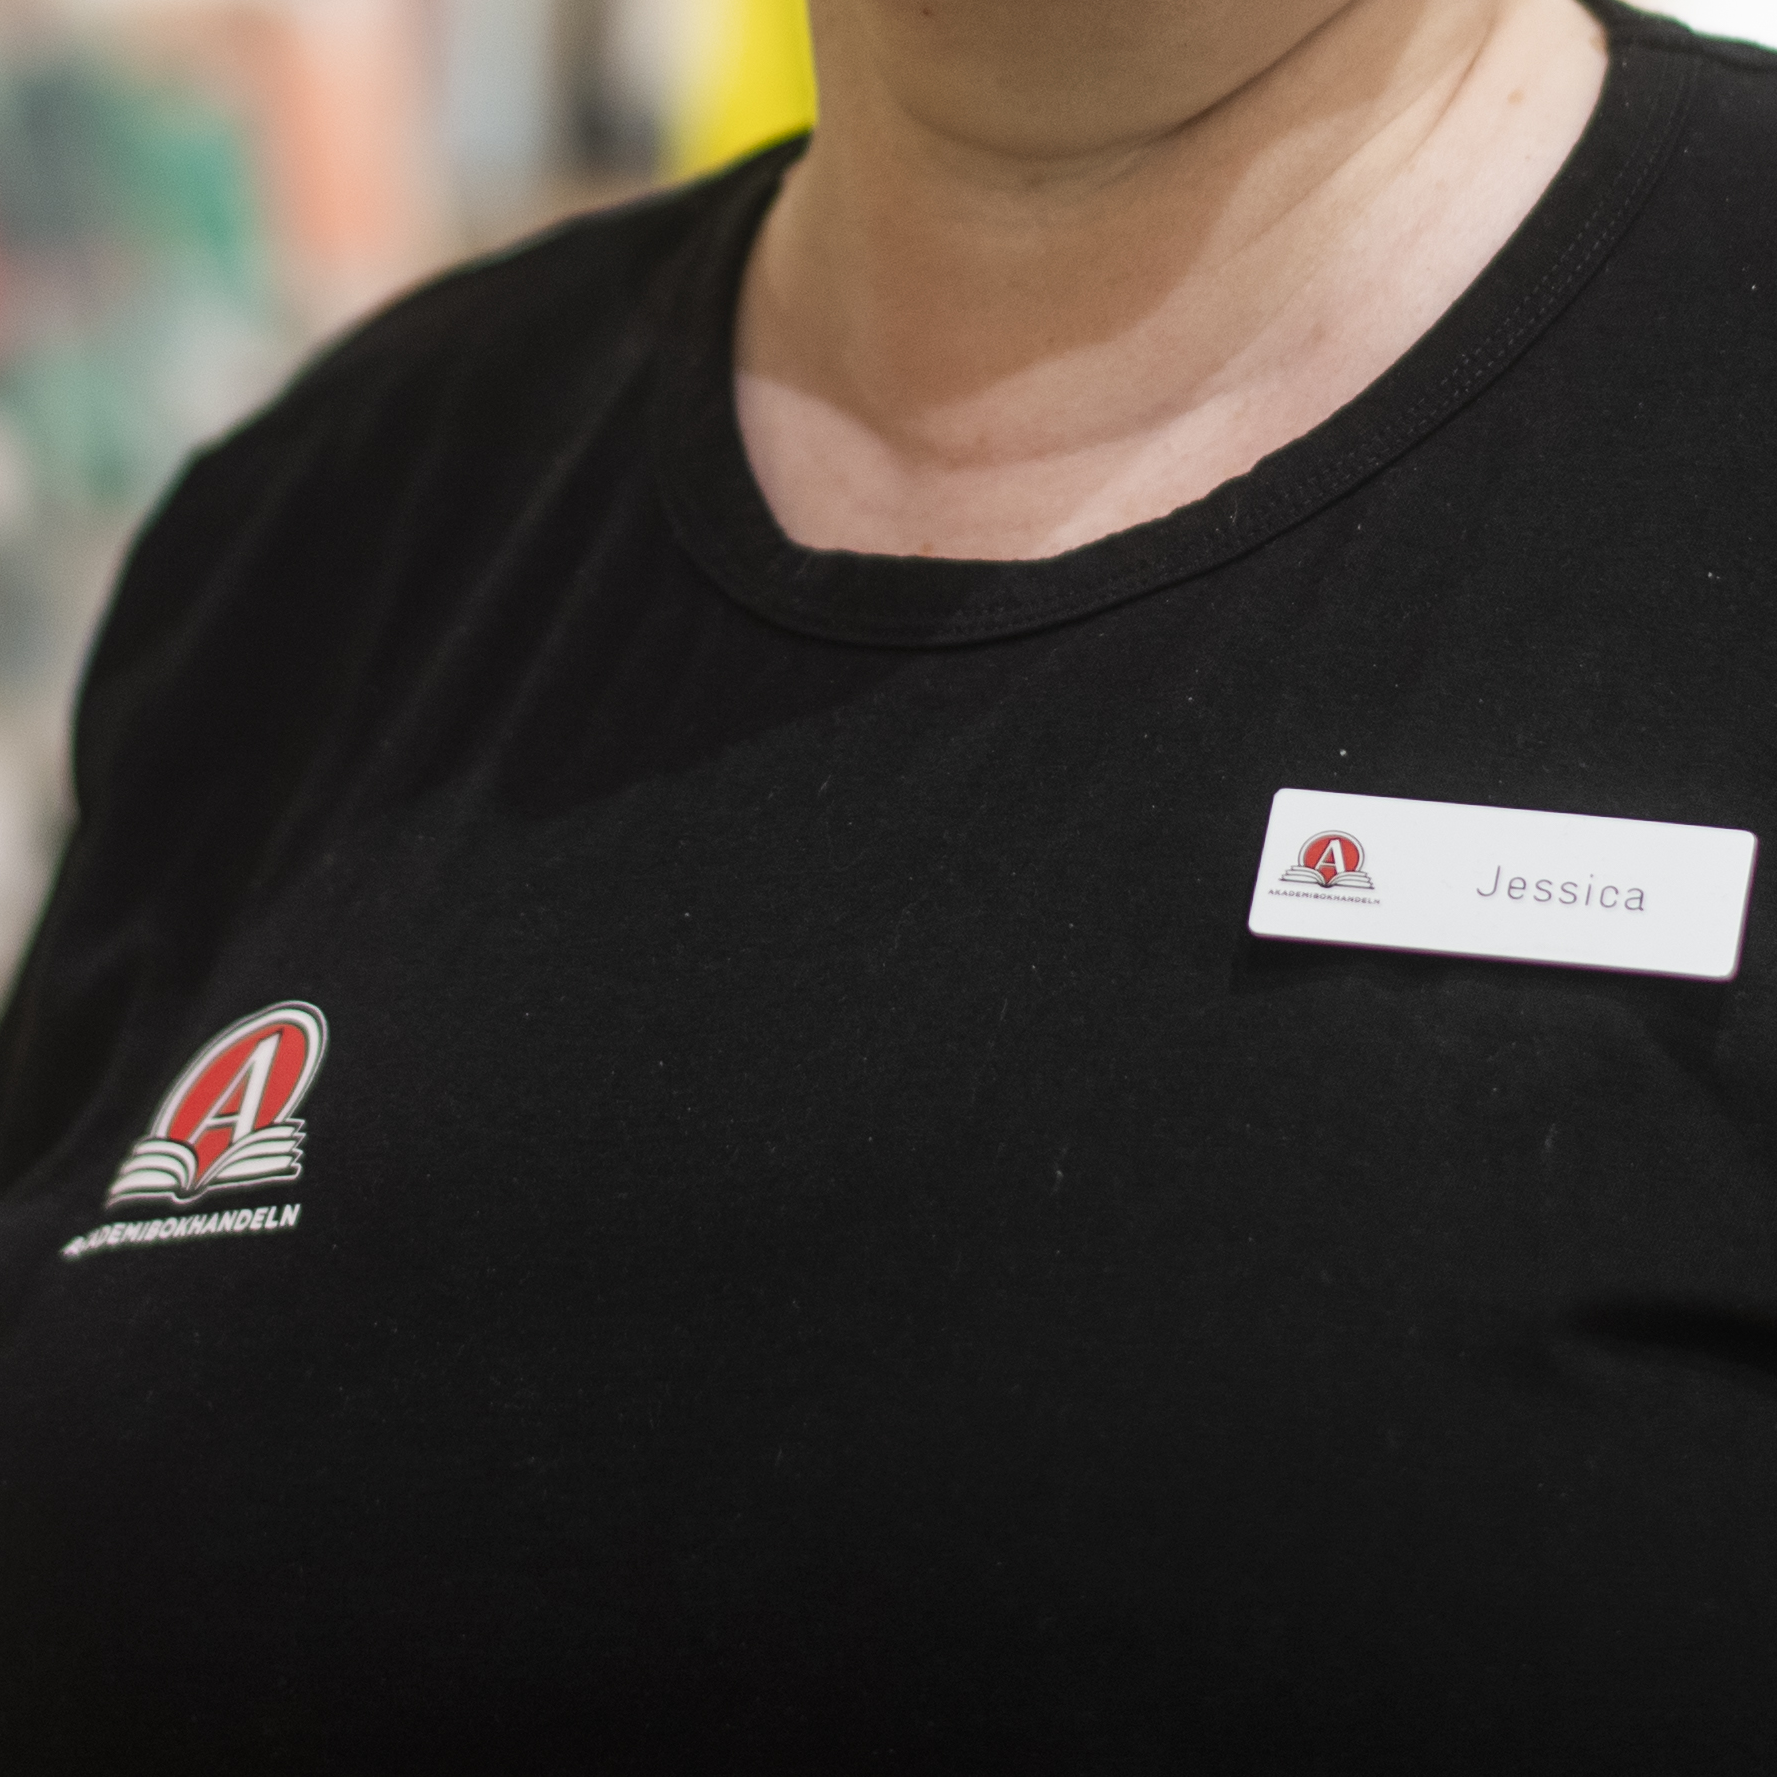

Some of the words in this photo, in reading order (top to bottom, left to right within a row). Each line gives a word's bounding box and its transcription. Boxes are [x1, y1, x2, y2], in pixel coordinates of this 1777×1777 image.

[1314, 838, 1346, 875] A
[1267, 888, 1382, 906] AKADEMIBOKHANDELN
[1476, 864, 1646, 912] Jessica
[186, 1028, 284, 1147] A
